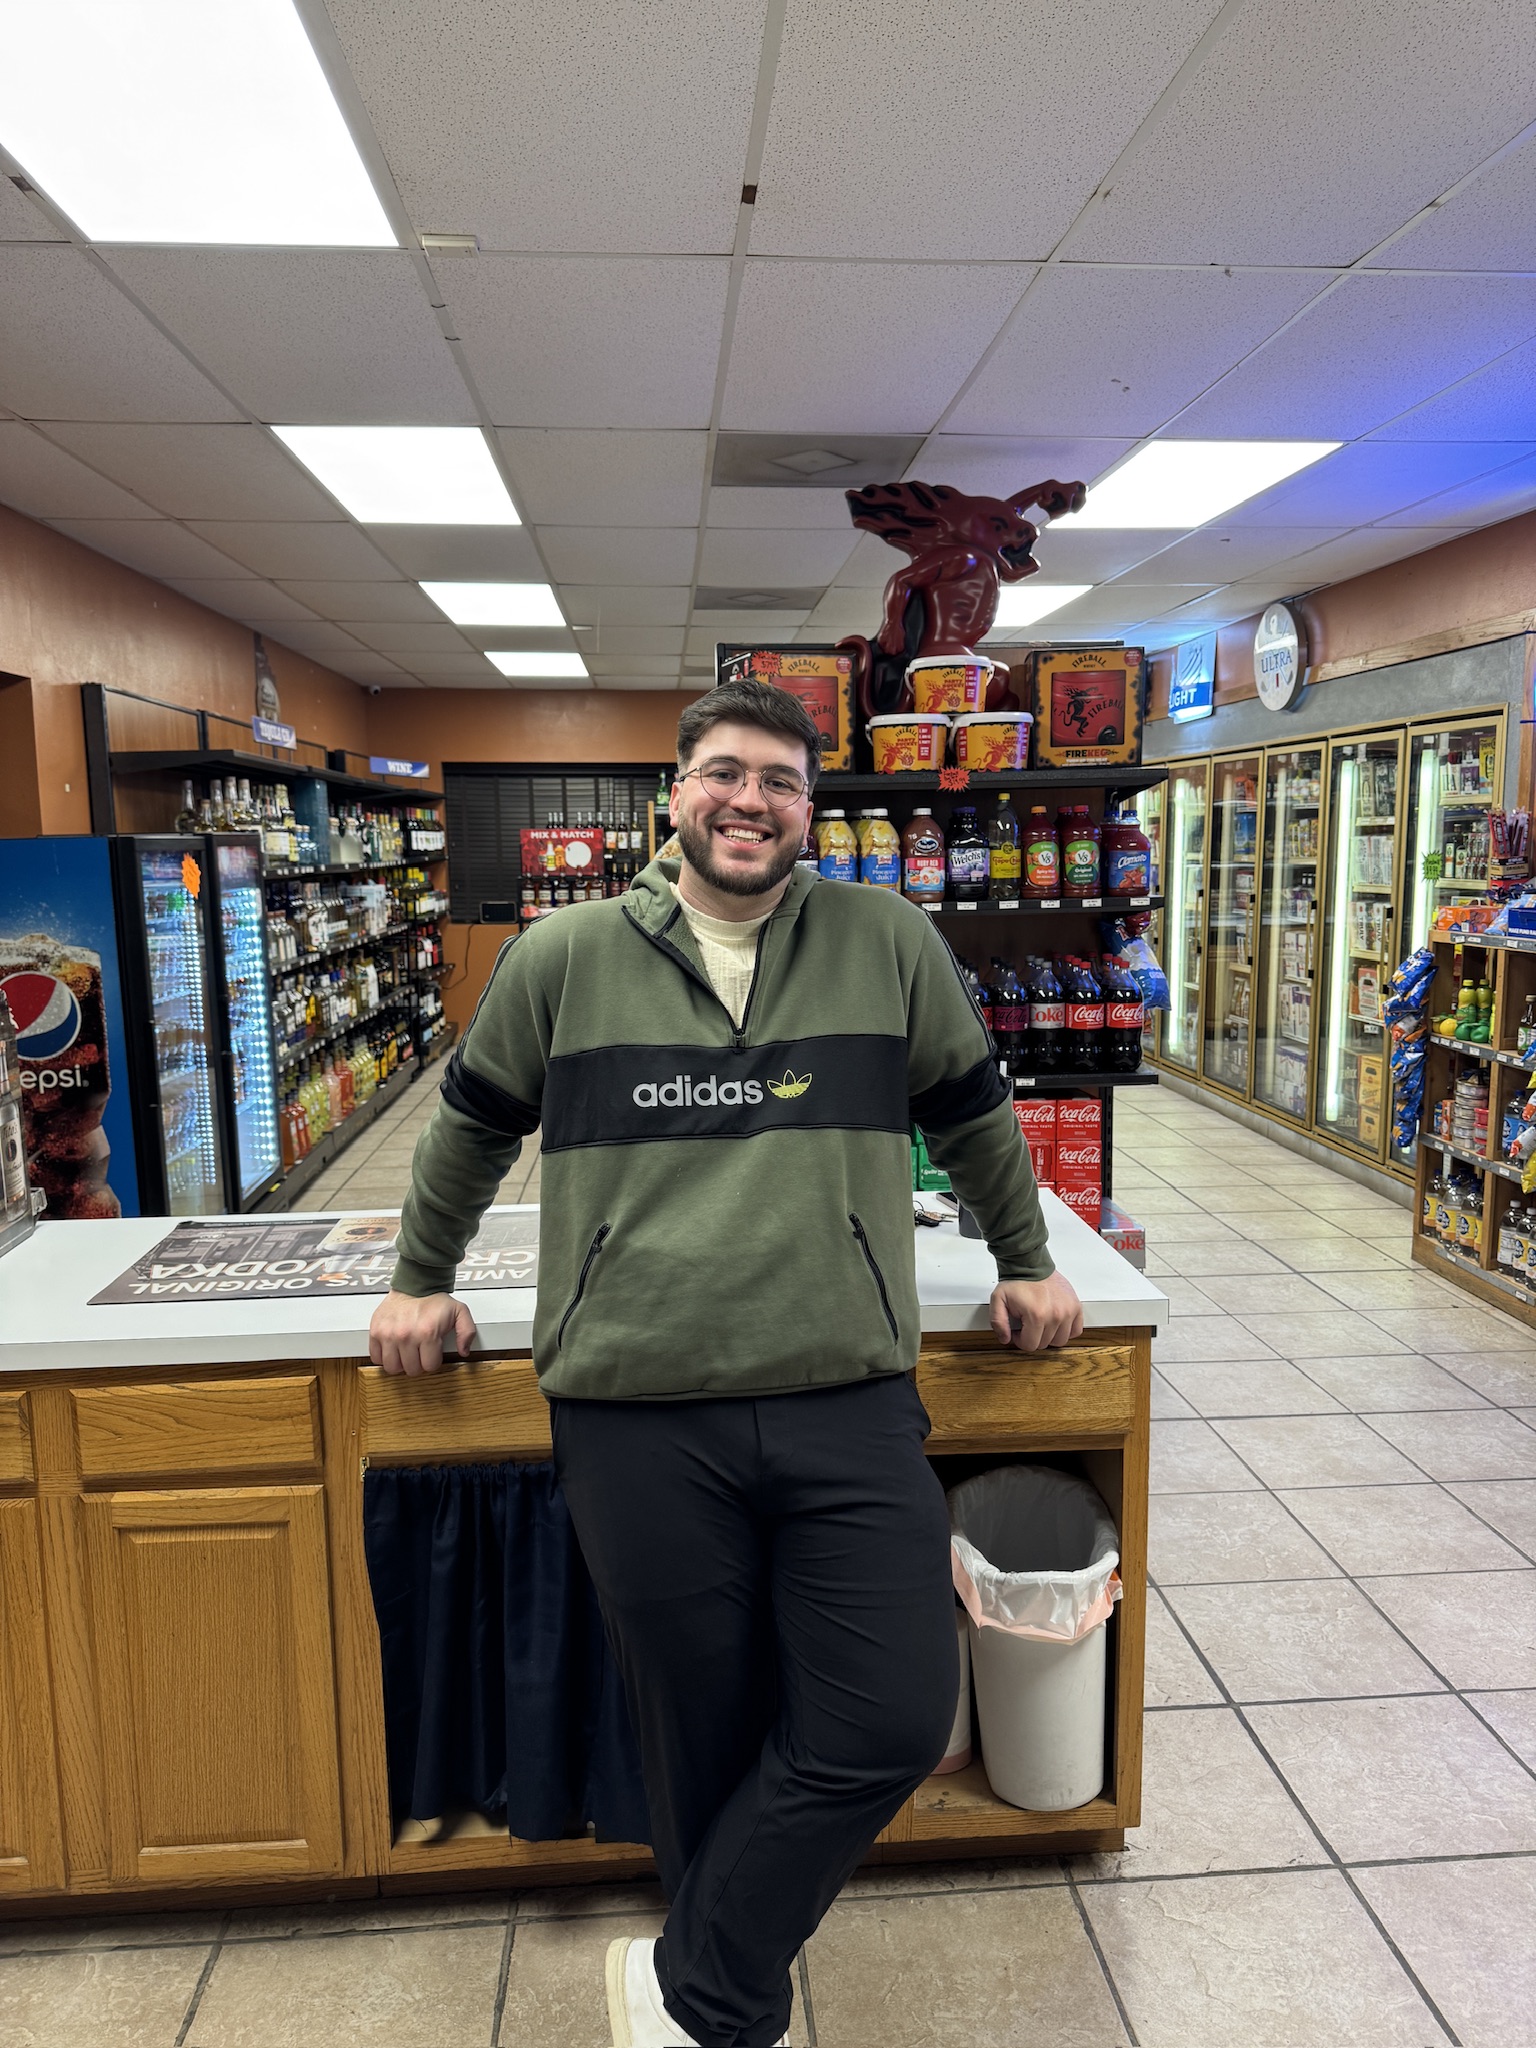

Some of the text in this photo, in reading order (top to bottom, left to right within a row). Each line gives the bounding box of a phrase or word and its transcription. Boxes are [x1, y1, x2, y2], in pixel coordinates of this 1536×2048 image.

[787, 658, 820, 673] FIREBALL
[1072, 654, 1107, 668] FIREBALL
[1260, 651, 1293, 674] ULTRA
[1065, 749, 1107, 758] FIREKEG
[387, 761, 413, 774] WINE
[530, 830, 594, 839] MIX & MATCH
[953, 851, 981, 866] Welch's
[1041, 852, 1052, 864] V8
[1078, 852, 1088, 863] V8
[1117, 853, 1147, 870] Clamato
[19, 1064, 82, 1094] epsi
[633, 1075, 764, 1107] adidas
[150, 1257, 333, 1279] VODKA
[128, 1278, 313, 1295] ORIGINAL
